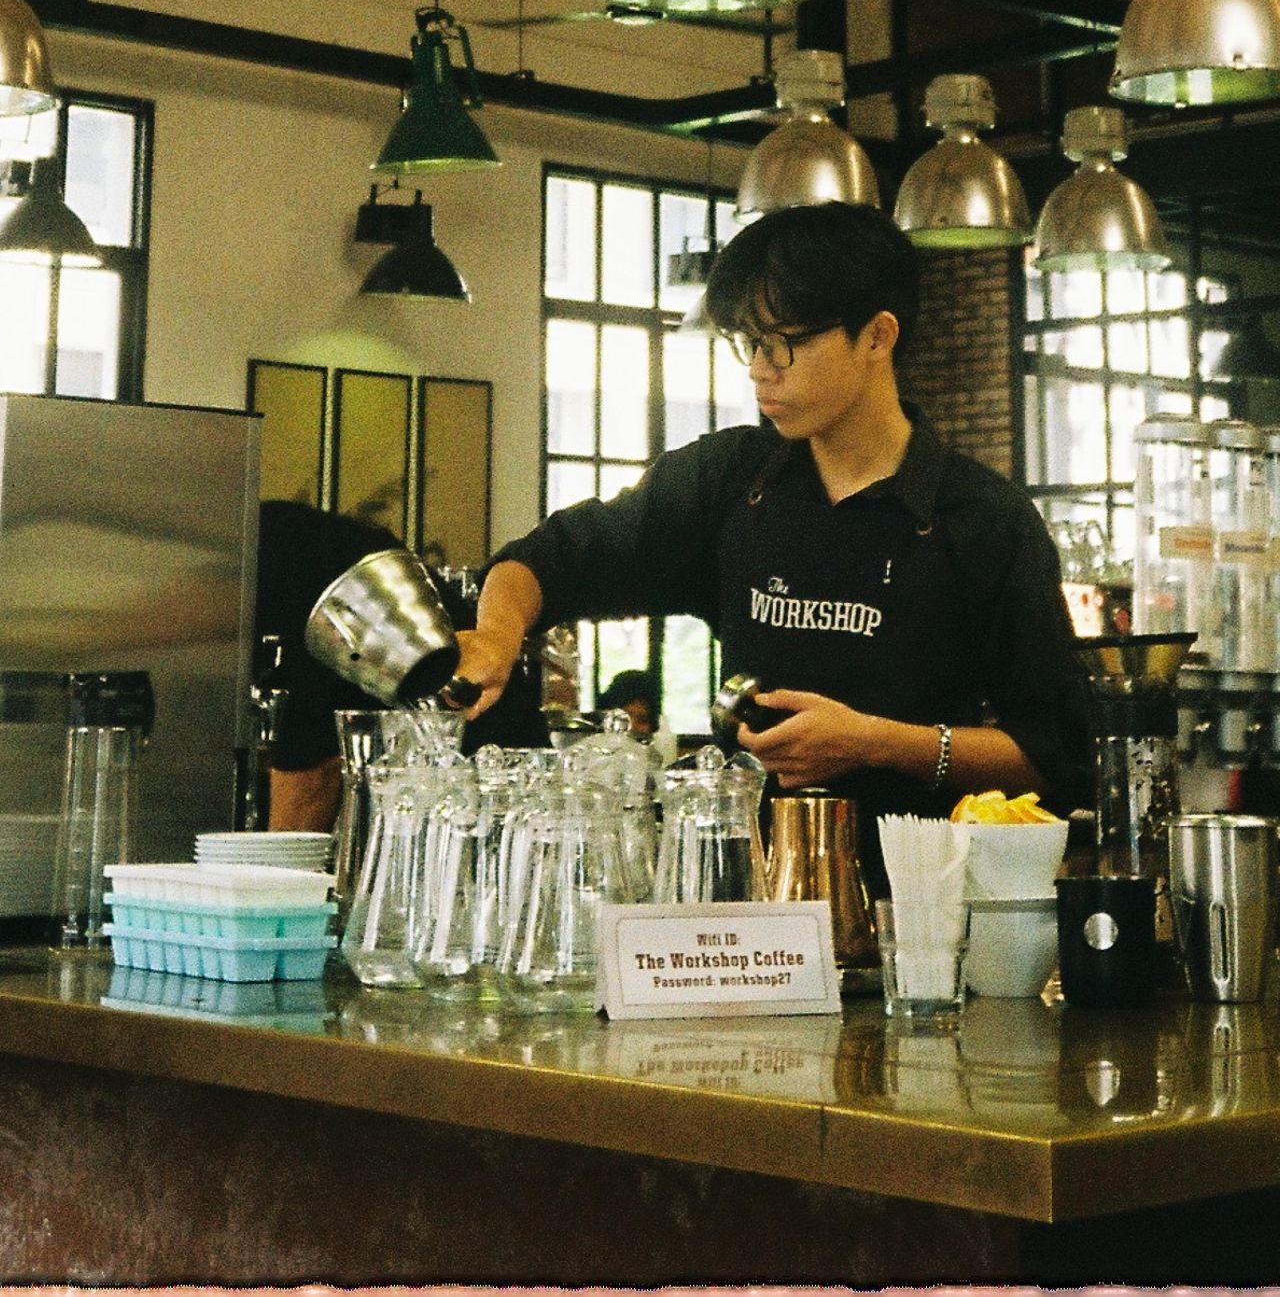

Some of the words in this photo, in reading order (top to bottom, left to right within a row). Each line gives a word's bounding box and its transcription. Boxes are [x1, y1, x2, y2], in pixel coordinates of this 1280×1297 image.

[750, 588, 882, 637] WORKSHOP
[724, 932, 741, 946] ID:
[635, 953, 665, 970] The
[670, 952, 749, 970] Workshop
[753, 950, 805, 967] Coffee
[653, 975, 715, 989] Password:
[719, 972, 792, 987] workshop27
